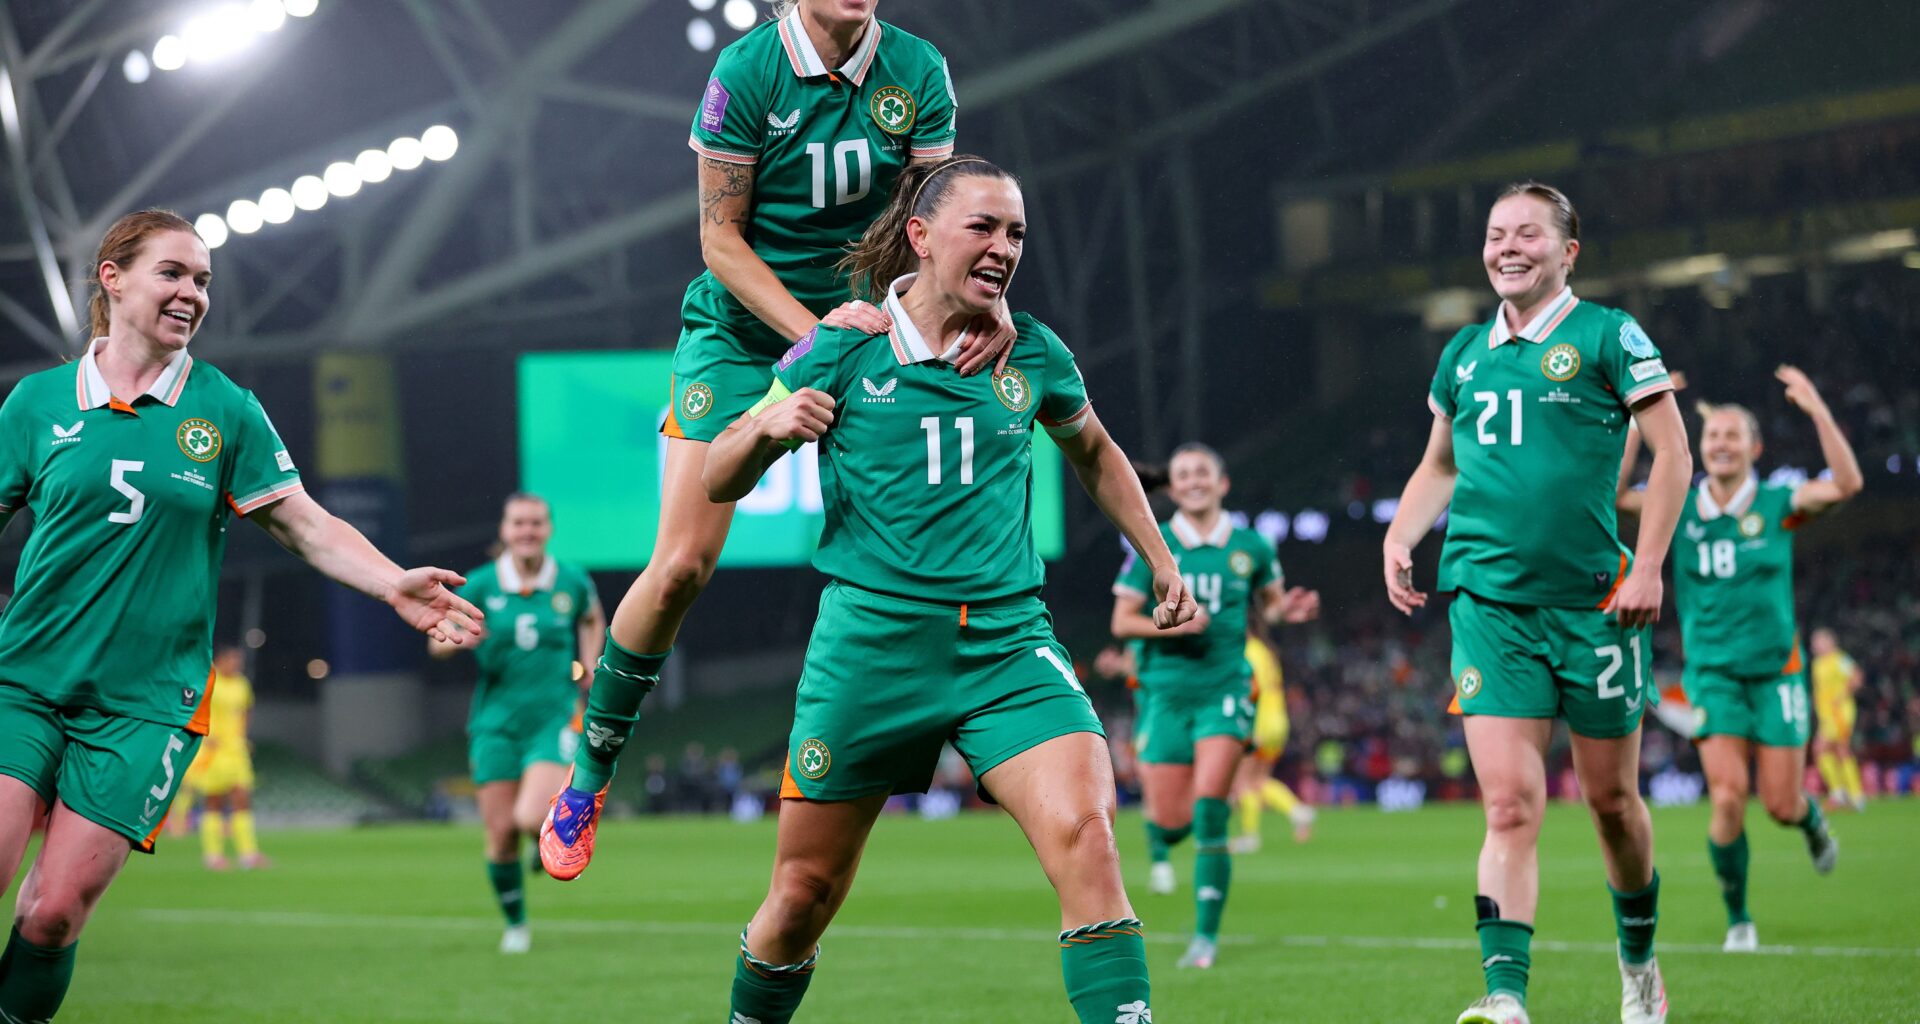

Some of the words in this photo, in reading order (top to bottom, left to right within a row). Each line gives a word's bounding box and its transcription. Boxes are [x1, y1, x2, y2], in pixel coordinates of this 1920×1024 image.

[874, 90, 911, 104] IRELAND
[806, 138, 871, 208] 10
[182, 421, 218, 438] IRELAND
[1474, 389, 1522, 445] 21
[920, 417, 974, 484] 11
[108, 459, 145, 524] 5
[1698, 539, 1736, 578] 18
[515, 613, 539, 650] 6
[1594, 635, 1643, 699] 21
[150, 733, 184, 801] 5
[801, 741, 828, 757] IRELAND
